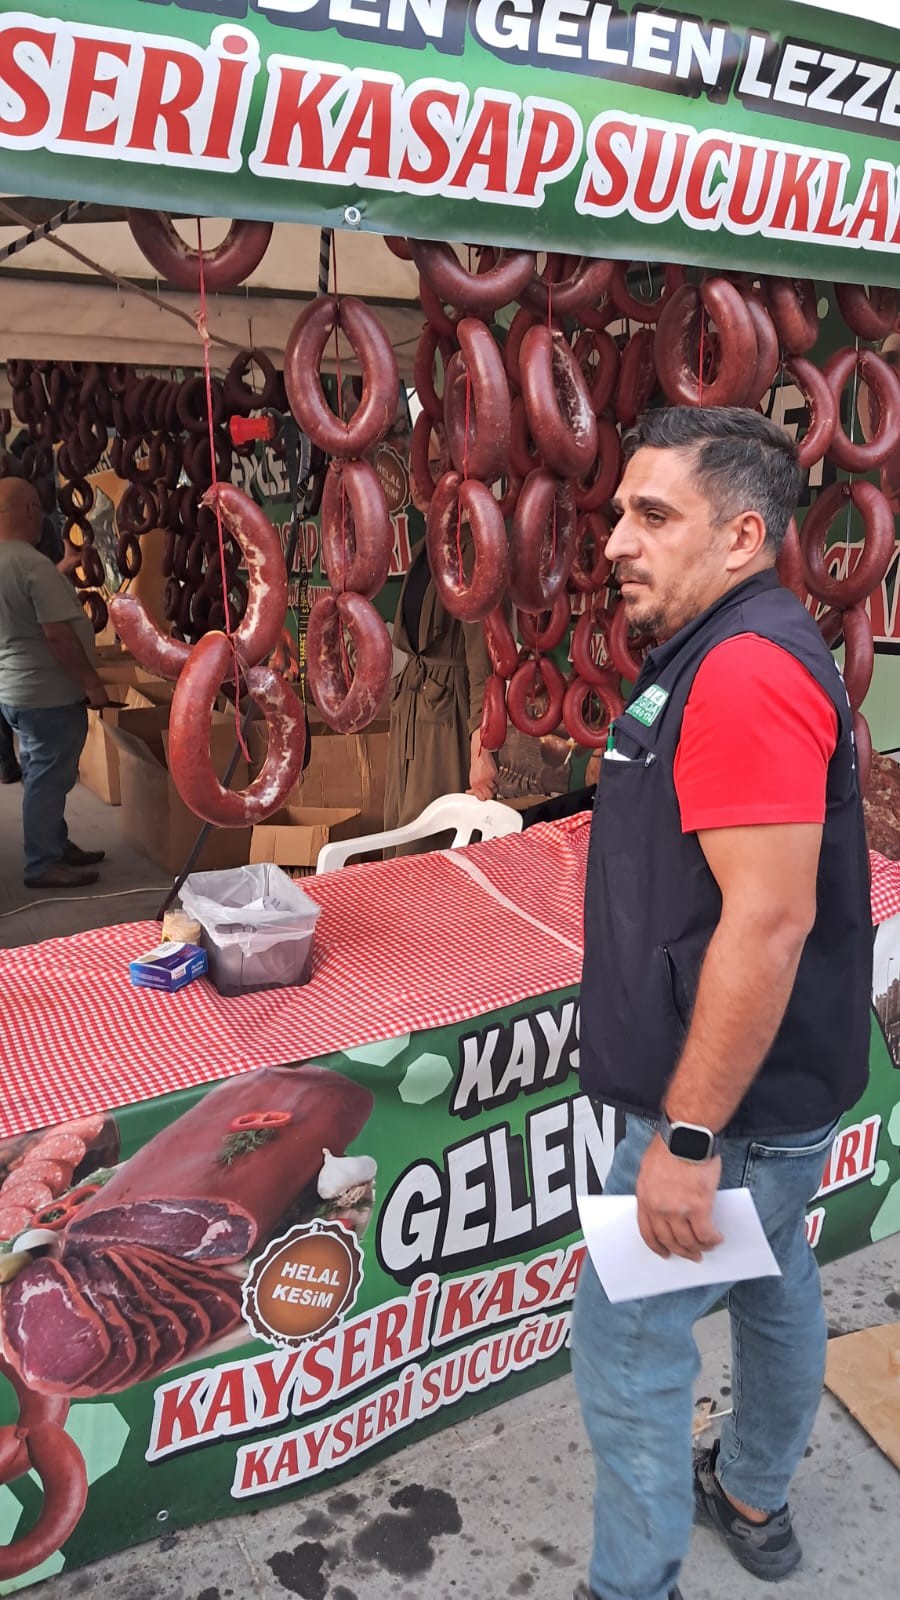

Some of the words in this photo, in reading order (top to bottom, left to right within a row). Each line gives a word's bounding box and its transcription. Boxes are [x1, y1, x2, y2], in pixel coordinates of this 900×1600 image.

[475, 0, 725, 86] GELEN
[0, 26, 249, 161] SERİ
[261, 67, 576, 196] KASAP
[584, 119, 900, 244] SUCUKLA
[380, 1094, 616, 1271] GELEN
[155, 1278, 434, 1452] KAYSERİ
[440, 1246, 587, 1338] KASA
[280, 1262, 341, 1287] HELAL
[239, 1371, 416, 1491] KAYSERİ
[421, 1317, 566, 1405] SUCUĞU
